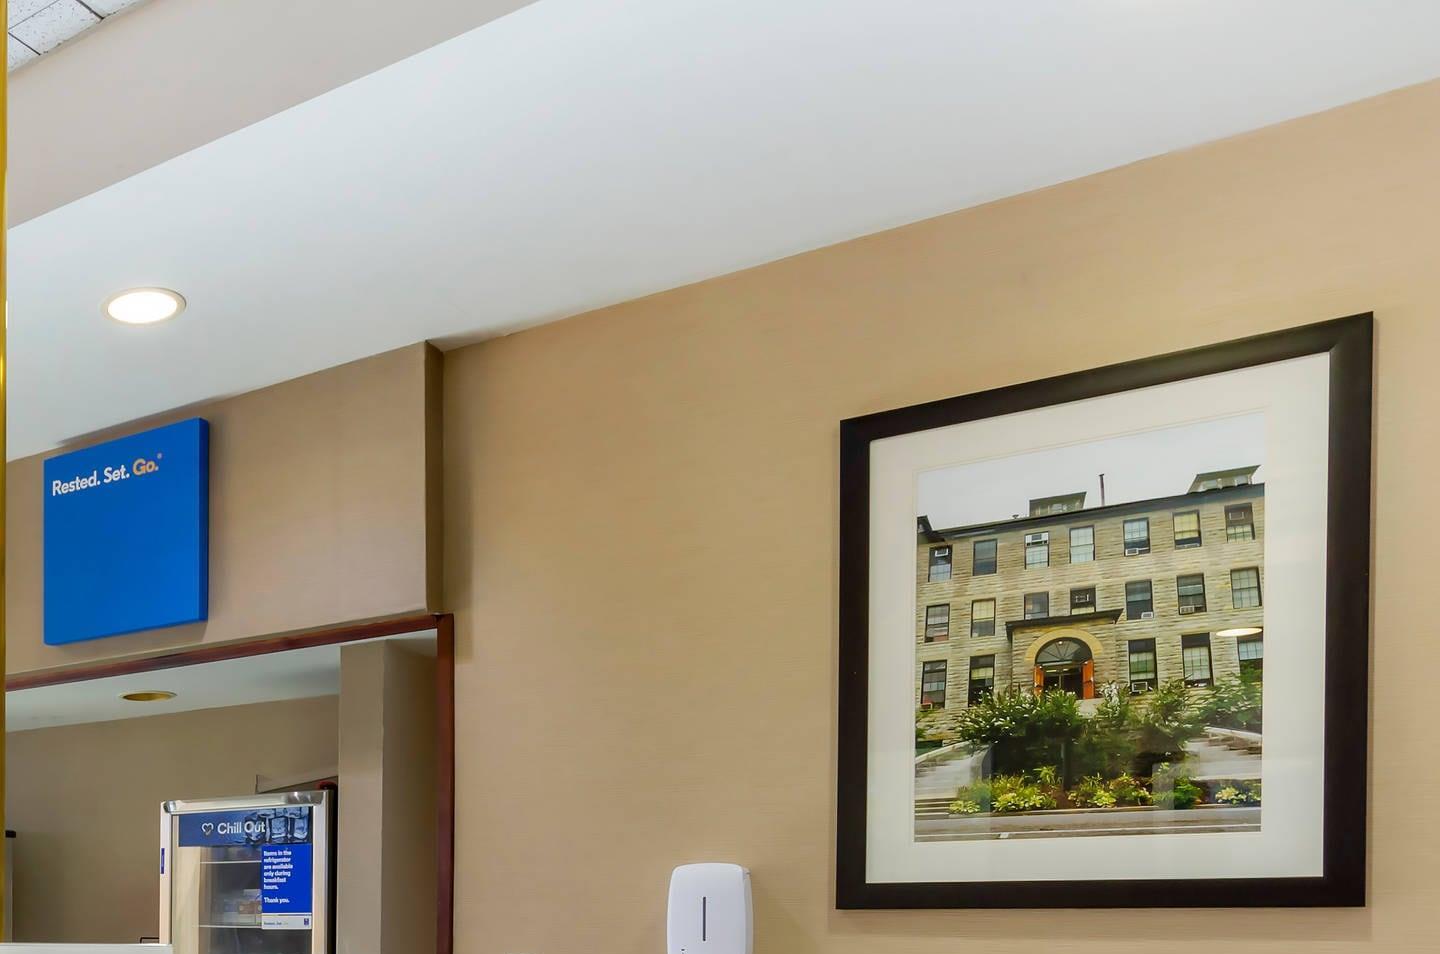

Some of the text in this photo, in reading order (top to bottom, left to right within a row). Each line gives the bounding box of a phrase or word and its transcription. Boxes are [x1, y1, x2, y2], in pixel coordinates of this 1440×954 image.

[52, 458, 159, 496] Rested. Set. Go.
[217, 821, 266, 834] Chill Out
